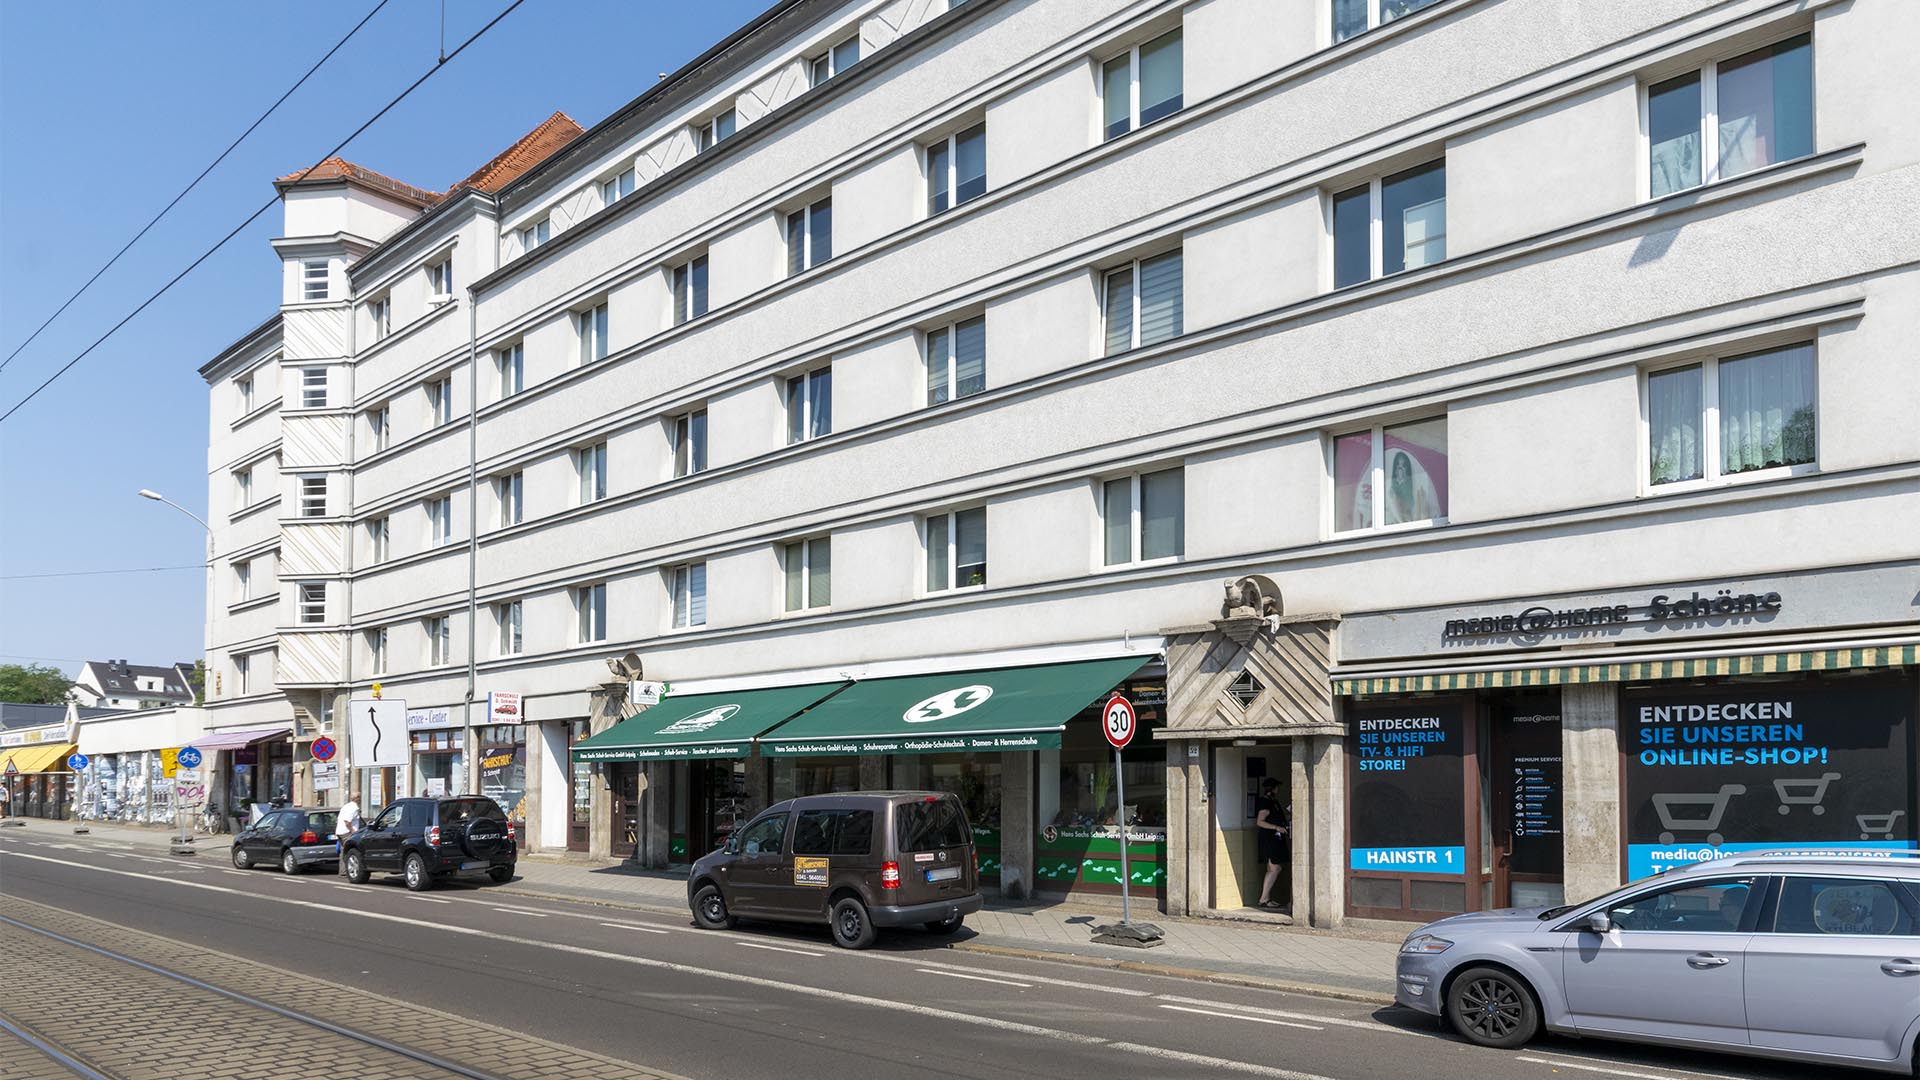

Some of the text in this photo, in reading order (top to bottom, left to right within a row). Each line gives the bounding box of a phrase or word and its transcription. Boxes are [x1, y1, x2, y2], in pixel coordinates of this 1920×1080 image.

[1651, 589, 1782, 618] Schöne
[408, 712, 424, 725] ervice
[429, 710, 447, 723] Center
[1640, 701, 1792, 723] ENTDECKEN
[1110, 710, 1129, 733] 30
[1360, 718, 1440, 731] ENTDECKEN
[1360, 731, 1446, 744] SIE UNSEREN
[1640, 724, 1803, 744] SIE UNSEREN
[841, 744, 857, 752] Leipzig
[863, 743, 898, 751] Schuhreparatur
[904, 739, 965, 750] Orthopädie-Schuhtechnik
[1000, 737, 1038, 746] Herrenschuhe
[1360, 745, 1424, 757] TV- & HIFI
[483, 753, 513, 769] FAHRSCHULE
[1640, 746, 1828, 766] ONLINE-SHOP!
[1360, 760, 1406, 771] STORE!
[470, 833, 500, 841] SUZUKI
[1075, 830, 1089, 838] Sachs
[1090, 831, 1122, 839] Schuh-Servi
[1126, 831, 1144, 840] GmbH
[1145, 831, 1165, 841] Leipzig
[1367, 850, 1452, 864] HAINSTR 1
